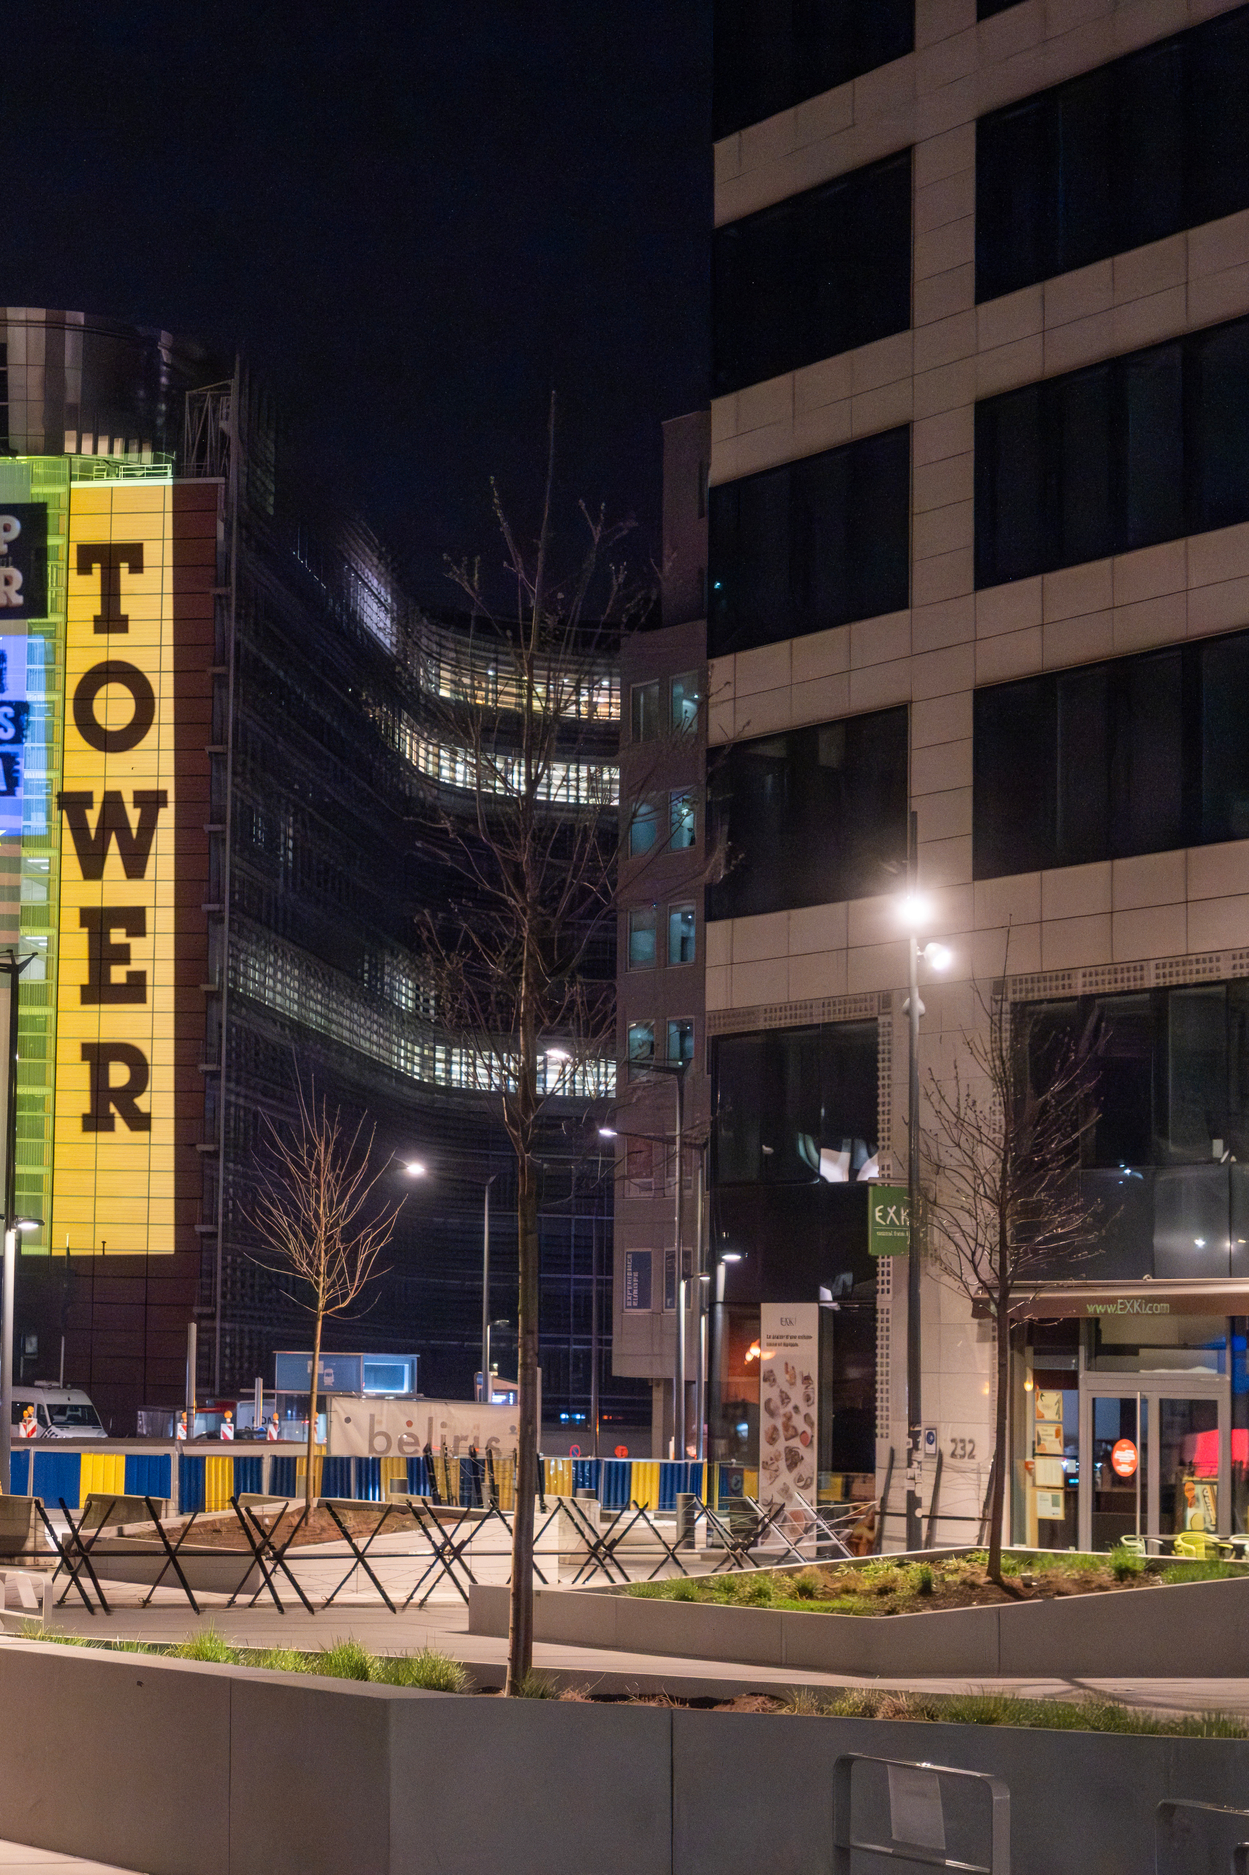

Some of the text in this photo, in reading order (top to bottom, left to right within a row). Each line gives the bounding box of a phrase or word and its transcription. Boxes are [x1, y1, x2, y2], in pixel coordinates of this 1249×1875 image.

[57, 543, 168, 1132] TOWER
[875, 1205, 909, 1225] EXK
[950, 1438, 977, 1460] 232
